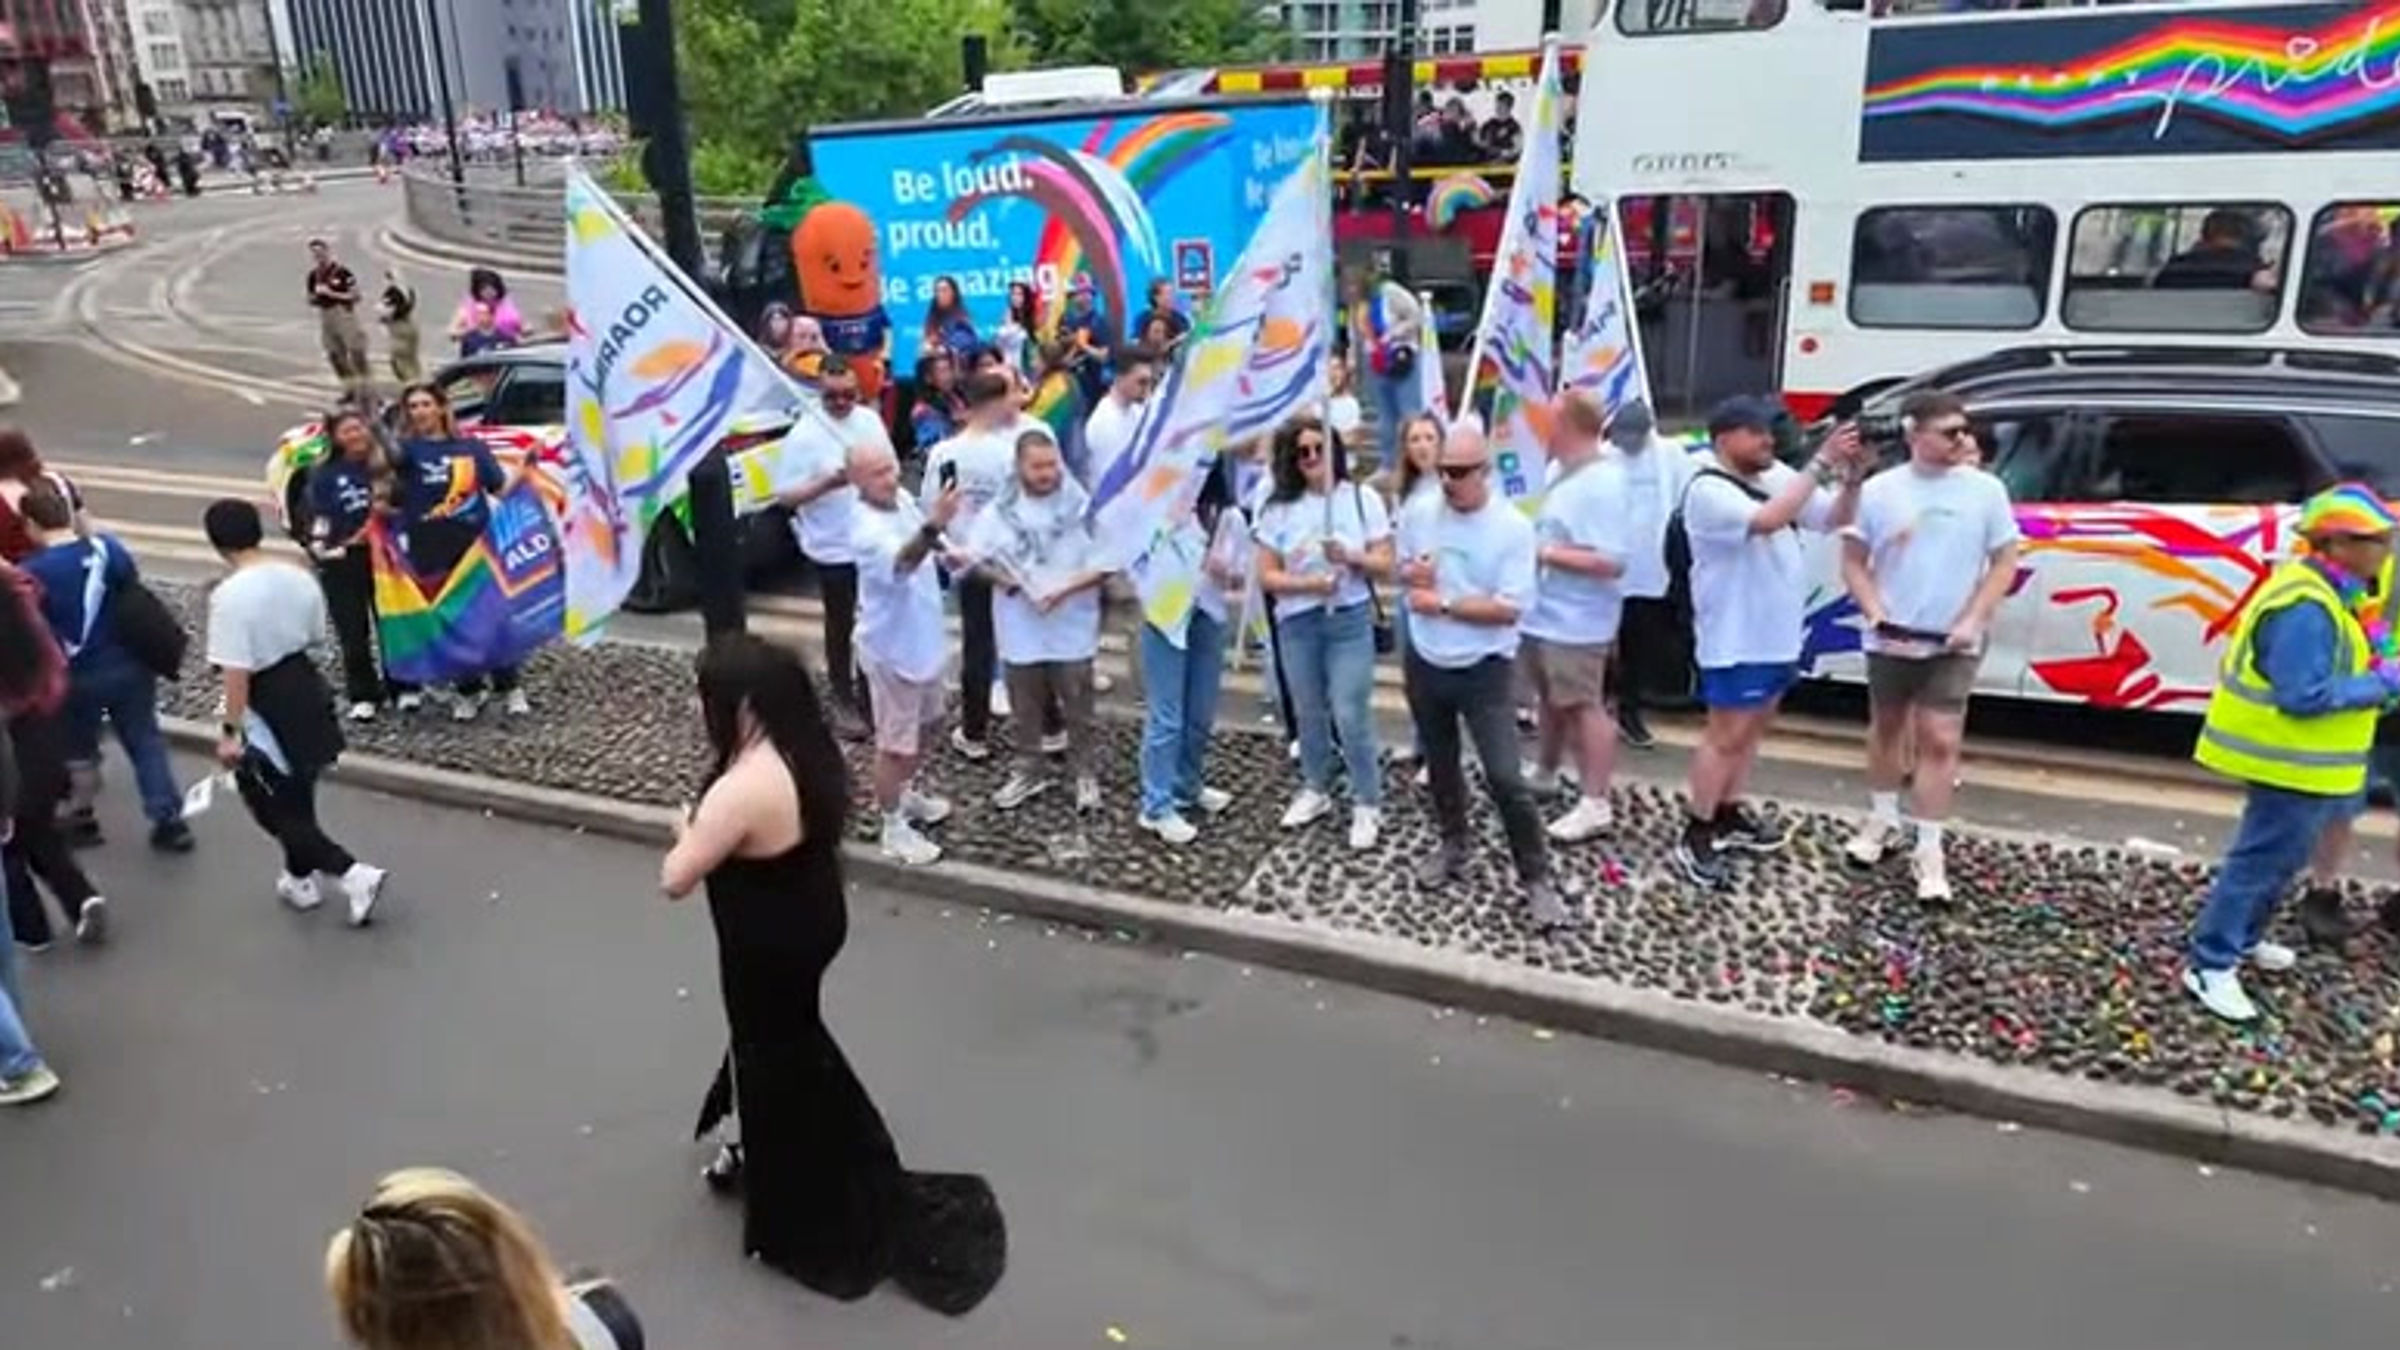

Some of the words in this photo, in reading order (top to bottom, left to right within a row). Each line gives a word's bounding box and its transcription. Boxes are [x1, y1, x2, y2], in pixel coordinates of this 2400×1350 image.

[2112, 16, 2400, 140] prid
[892, 168, 937, 204] Be
[942, 152, 1034, 199] loud.
[888, 211, 999, 257] proud.
[506, 533, 551, 571] ALD
